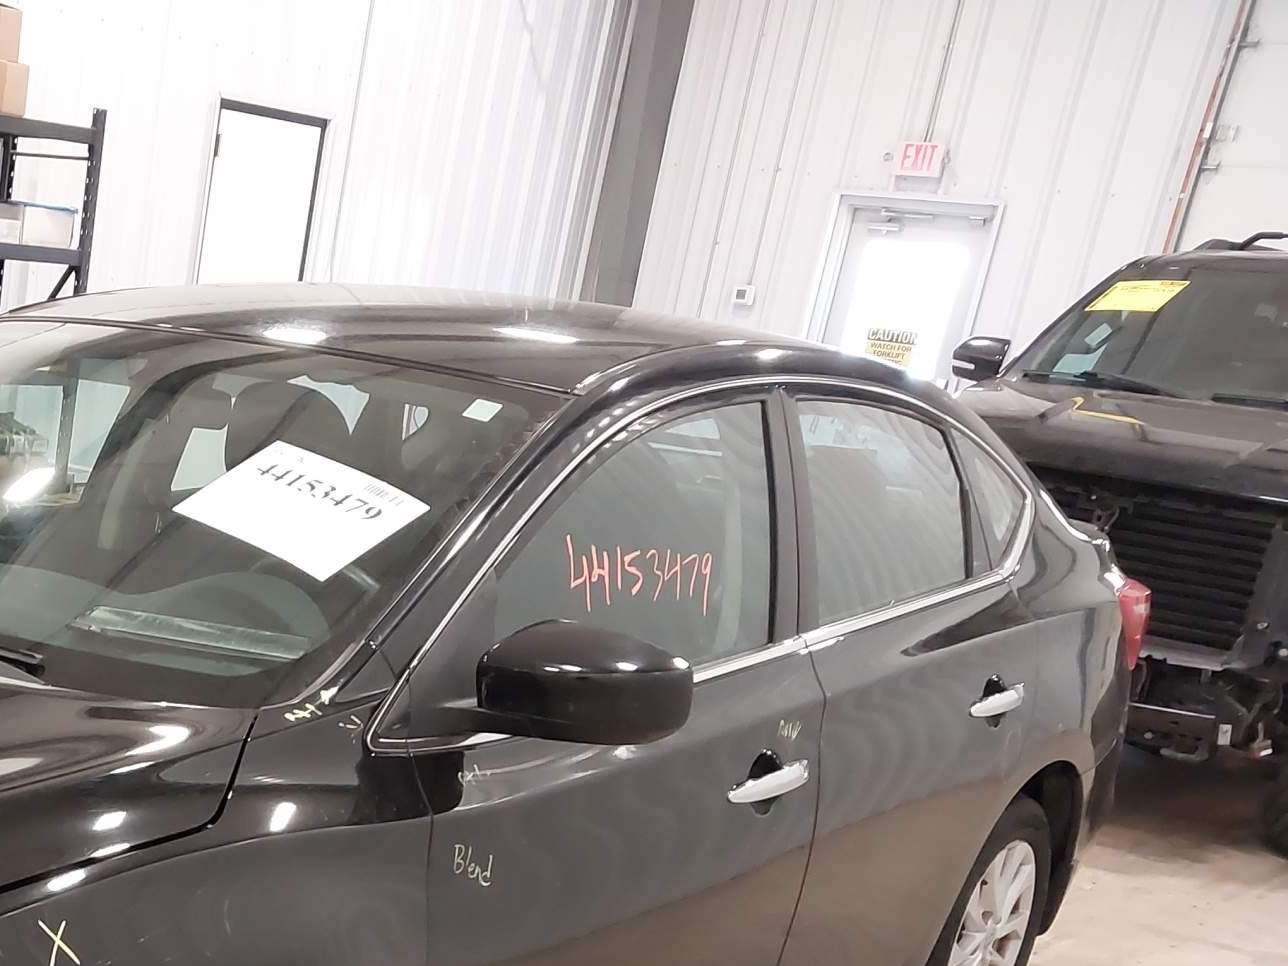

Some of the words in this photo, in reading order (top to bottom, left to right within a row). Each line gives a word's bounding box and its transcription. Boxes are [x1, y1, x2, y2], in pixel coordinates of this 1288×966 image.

[900, 143, 938, 172] EXIT
[871, 342, 896, 351] WATCH
[257, 464, 383, 520] 44153479
[565, 533, 713, 617] 44153479
[453, 843, 494, 887] Blend
